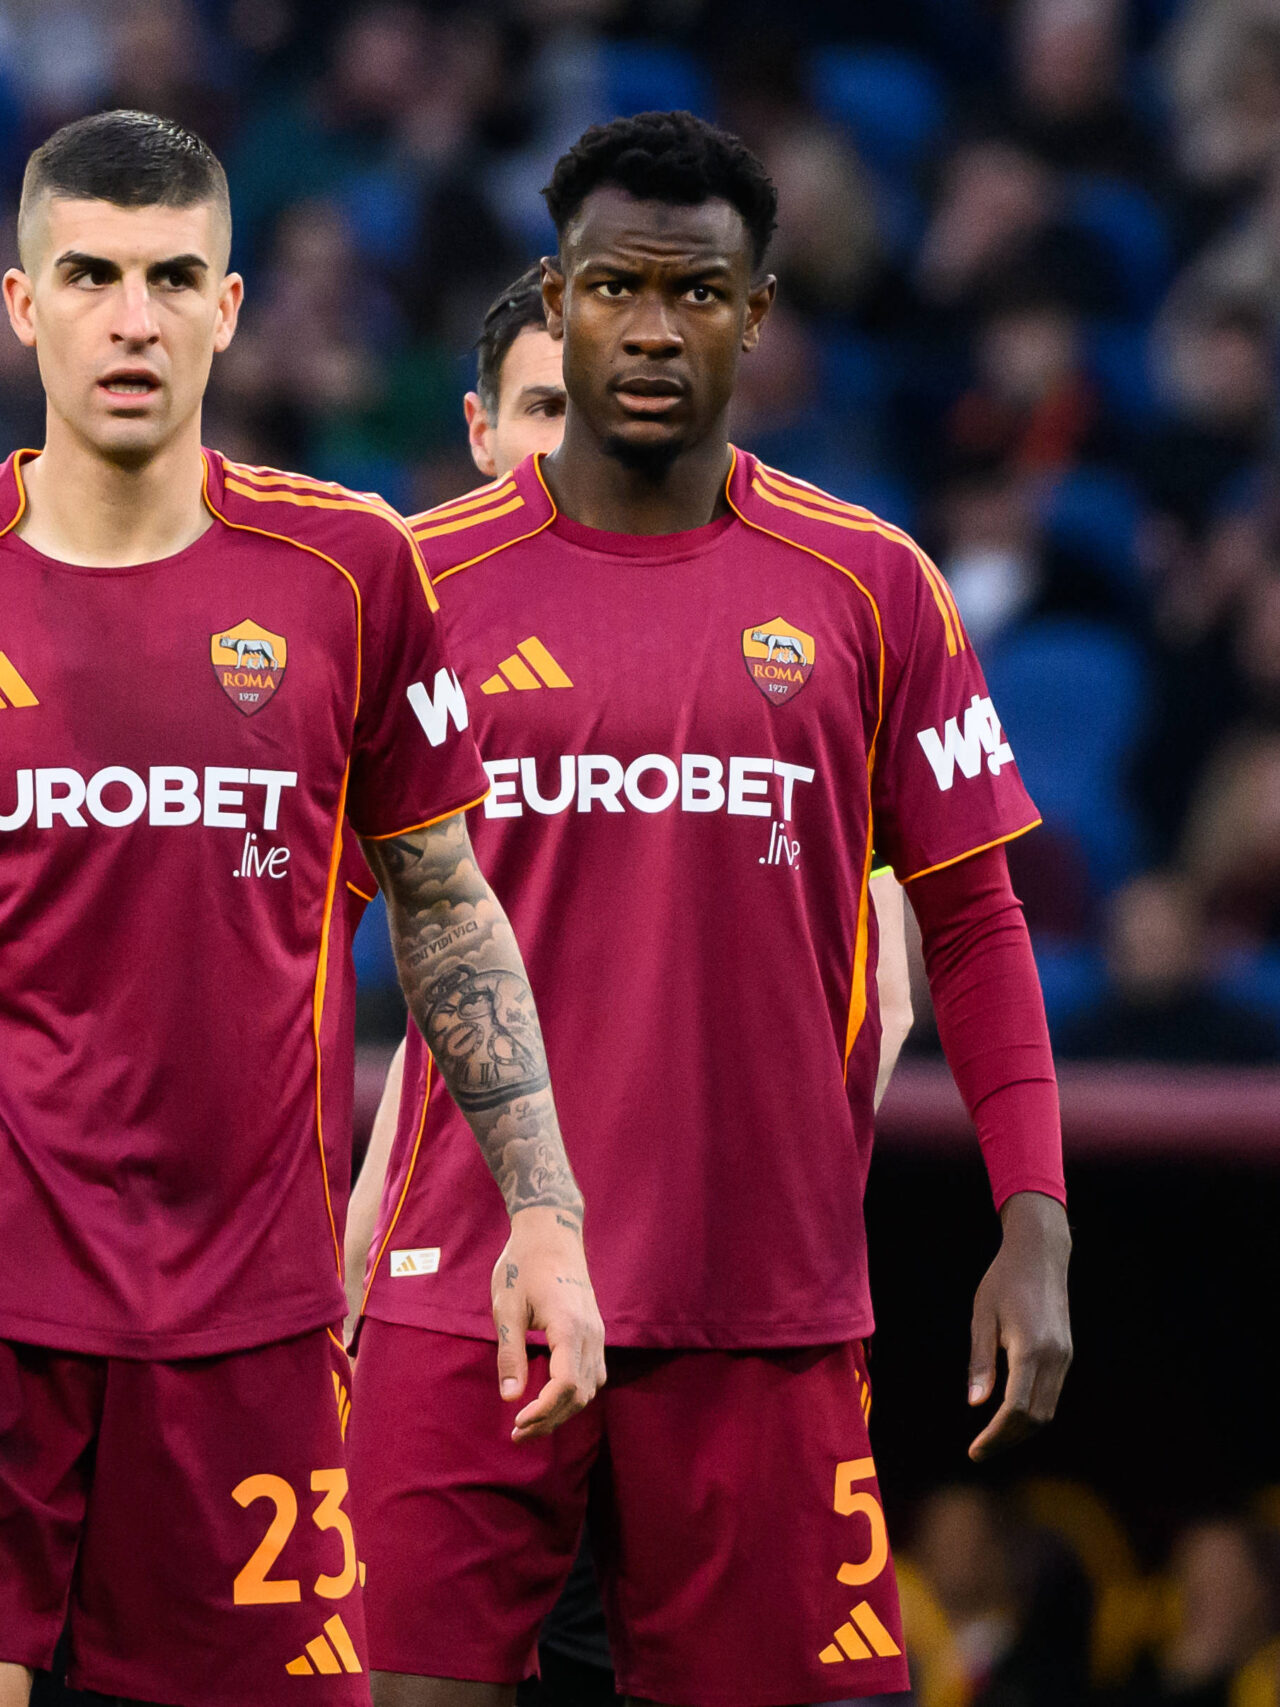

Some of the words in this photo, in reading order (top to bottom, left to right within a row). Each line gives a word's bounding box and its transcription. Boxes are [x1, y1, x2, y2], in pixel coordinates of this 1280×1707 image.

[223, 672, 276, 689] ROMA
[753, 664, 805, 684] ROMA
[768, 684, 788, 694] 1927
[239, 692, 260, 702] 1927
[482, 753, 815, 822] EUROBET
[233, 831, 291, 879] .live
[429, 933, 453, 954] VIDI
[453, 920, 479, 938] VICI
[231, 1468, 366, 1605] 23
[833, 1456, 889, 1586] 5
